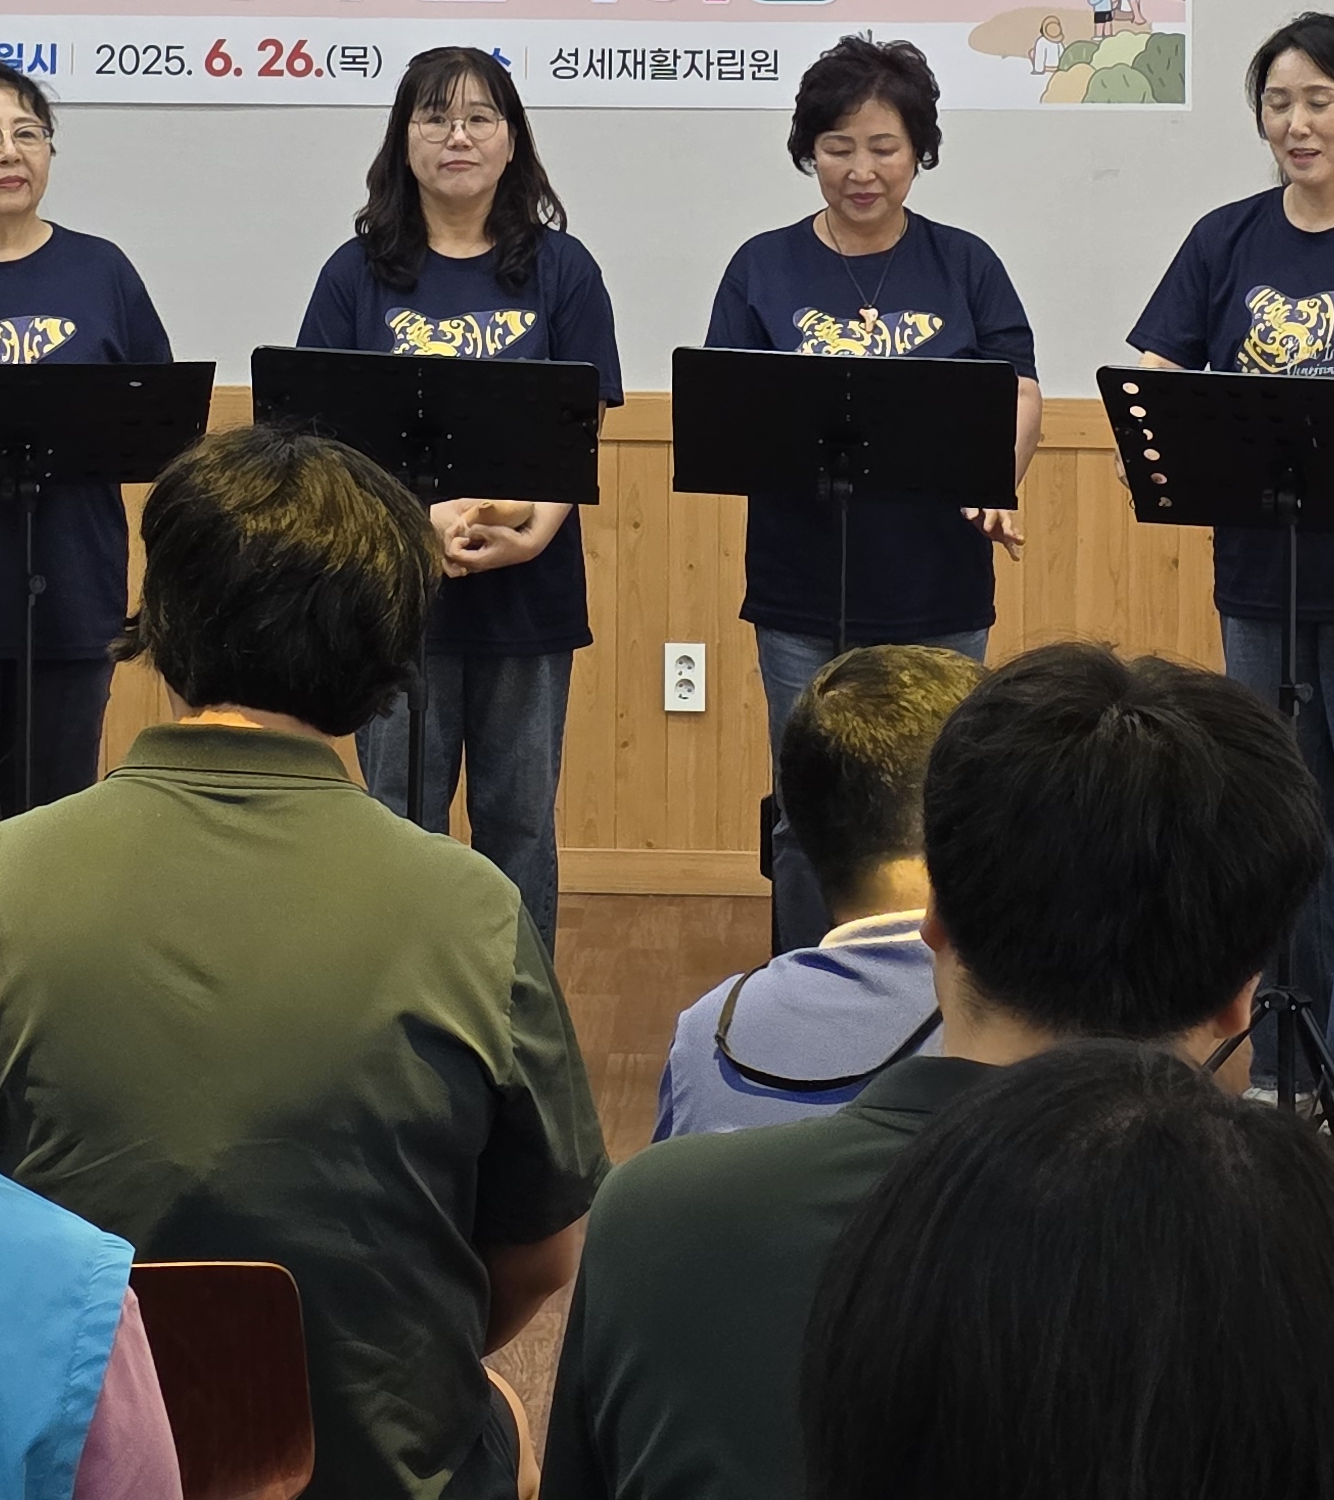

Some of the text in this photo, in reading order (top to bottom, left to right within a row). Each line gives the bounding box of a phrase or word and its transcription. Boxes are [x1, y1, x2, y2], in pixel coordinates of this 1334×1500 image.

[95, 44, 194, 76] 2025.
[204, 38, 244, 78] 6.
[549, 46, 779, 82] 성세재활자립원
